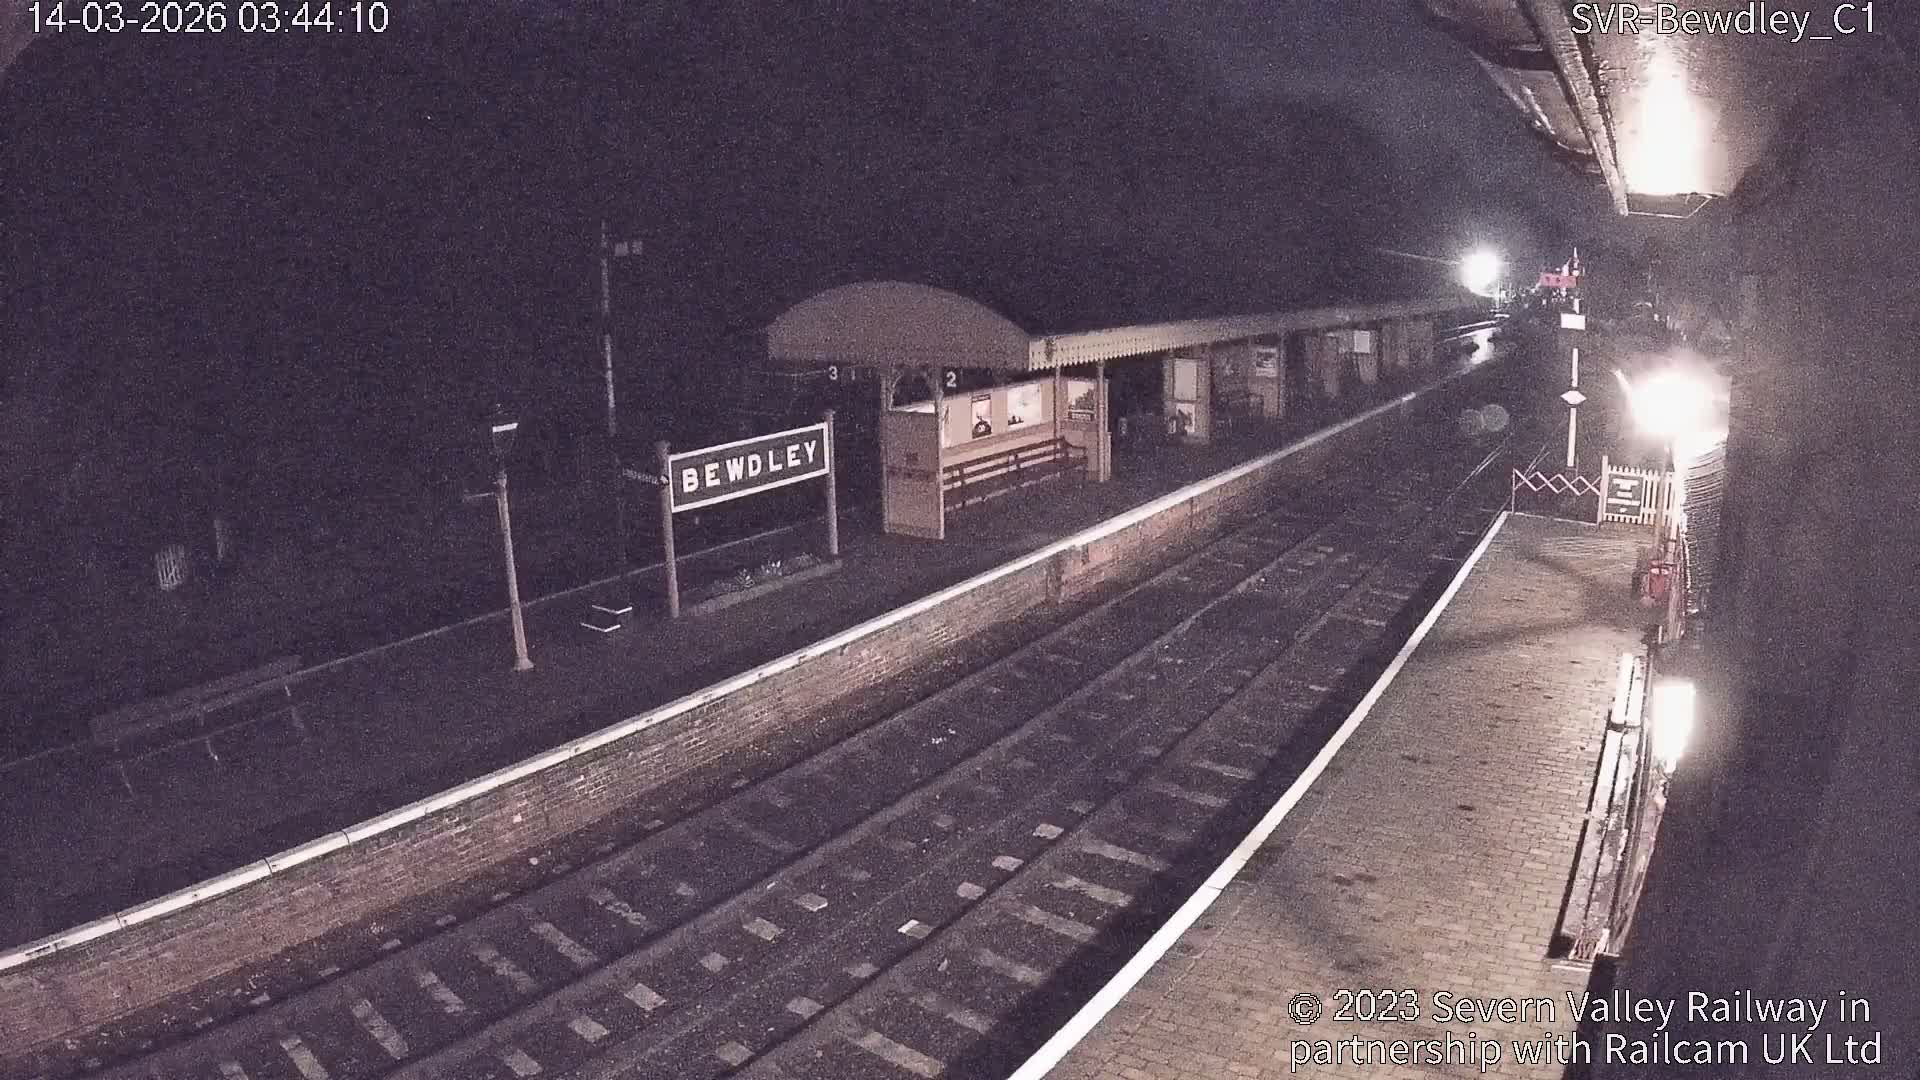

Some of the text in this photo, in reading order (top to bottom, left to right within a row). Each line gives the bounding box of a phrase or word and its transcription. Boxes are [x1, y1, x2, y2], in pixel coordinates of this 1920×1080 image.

[828, 365, 838, 380] 3
[945, 371, 957, 388] 2
[682, 440, 818, 494] BEWDLEY
